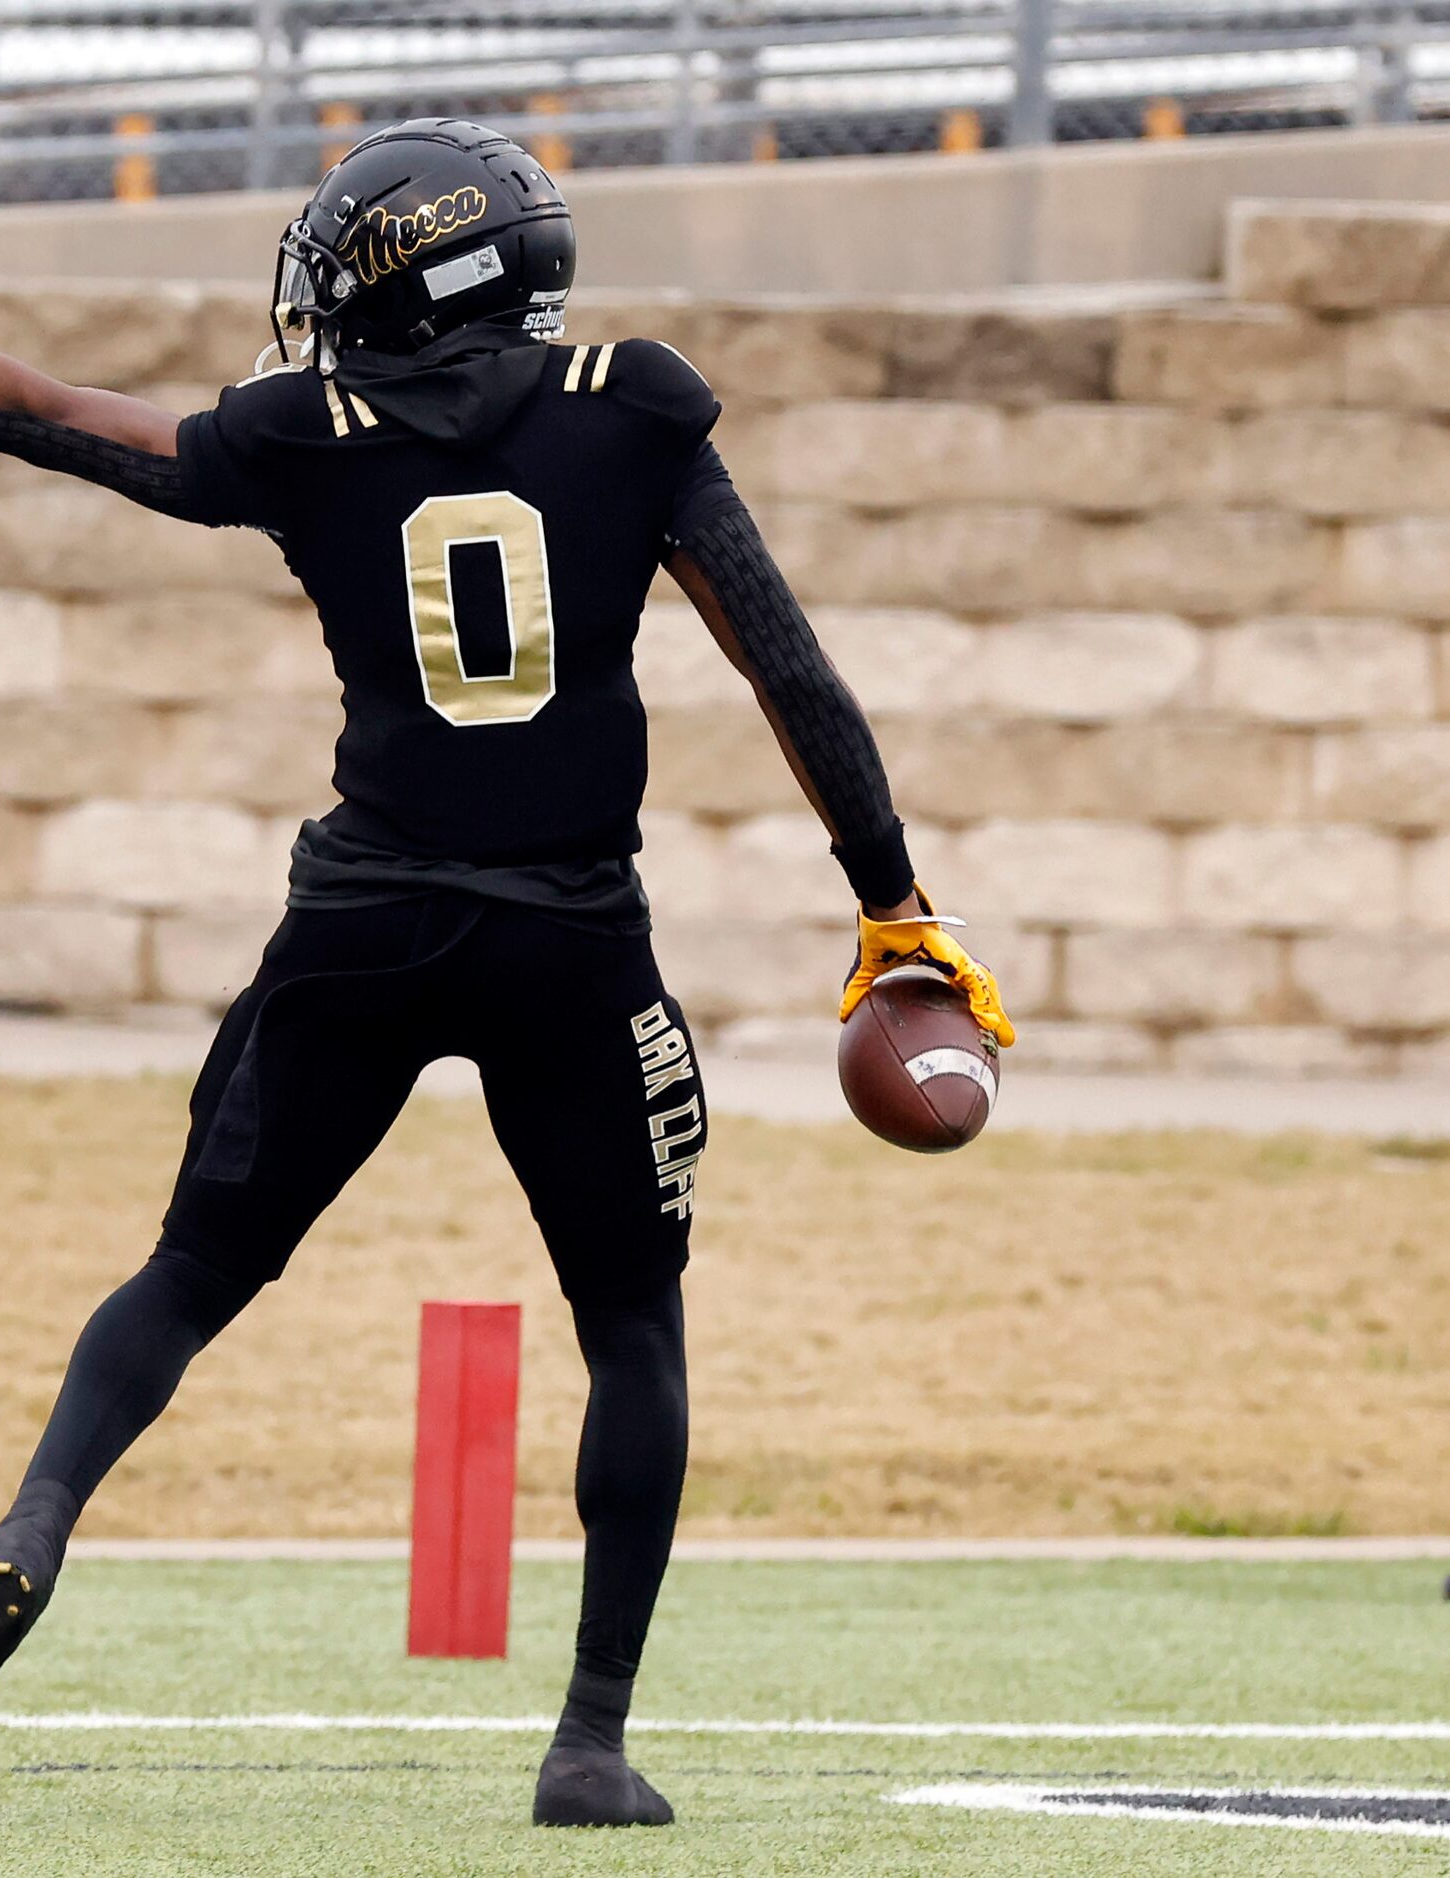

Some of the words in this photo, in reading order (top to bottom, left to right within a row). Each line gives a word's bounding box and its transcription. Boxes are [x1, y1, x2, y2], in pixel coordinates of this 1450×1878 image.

[338, 185, 487, 285] Mecca
[401, 490, 556, 727] 0
[630, 1000, 694, 1101] OAK
[648, 1093, 704, 1221] CLIFF
